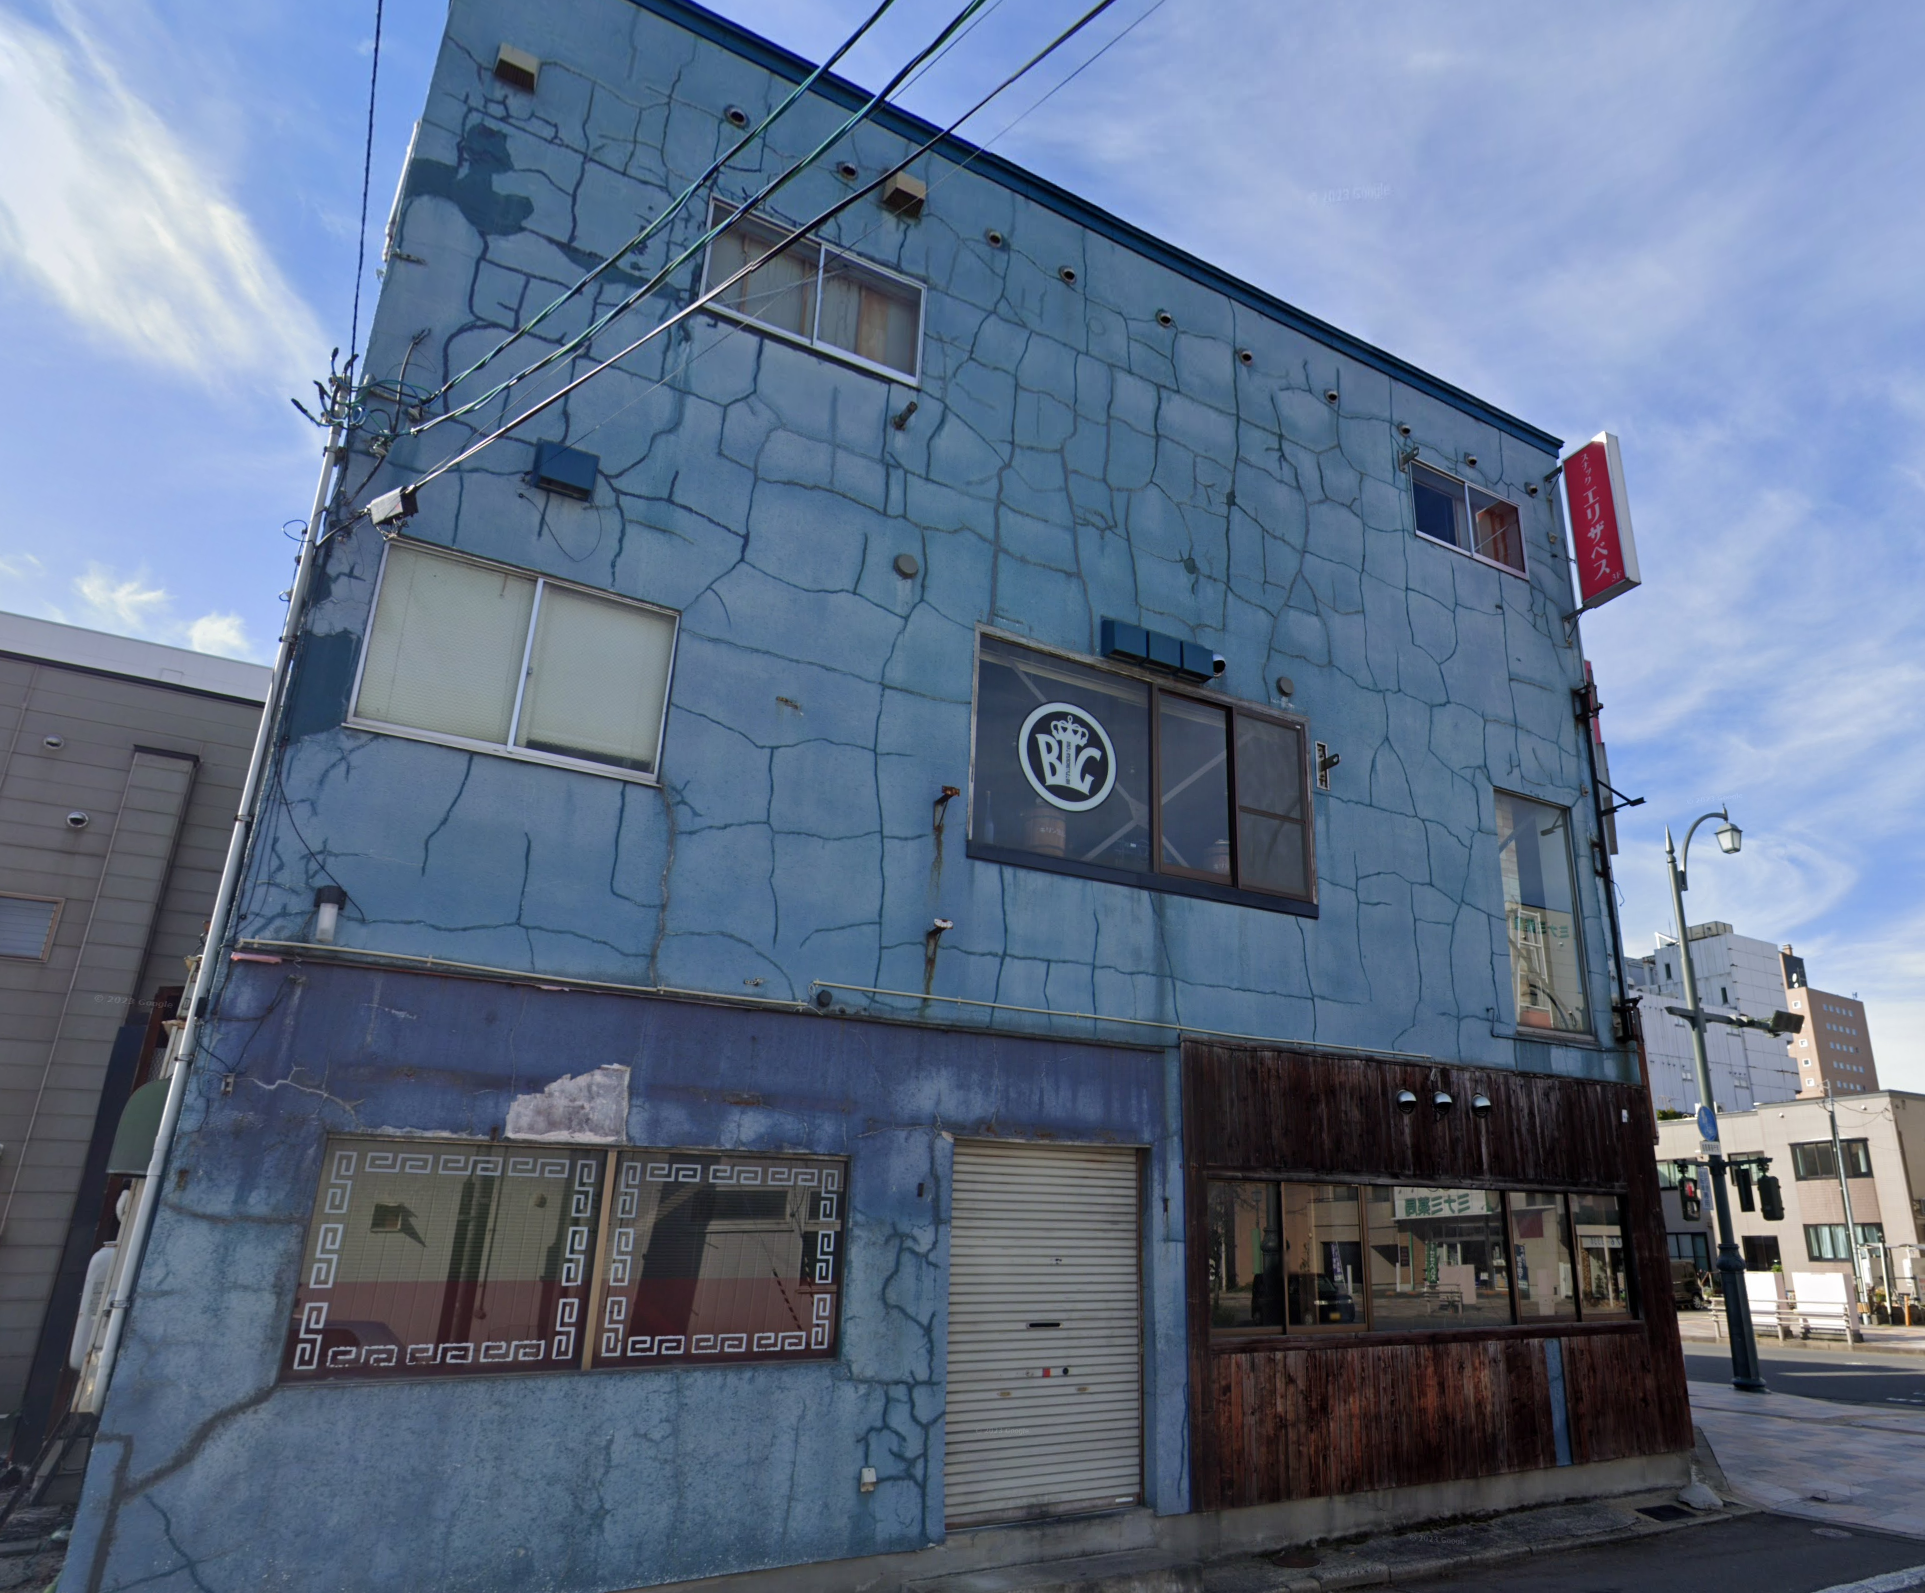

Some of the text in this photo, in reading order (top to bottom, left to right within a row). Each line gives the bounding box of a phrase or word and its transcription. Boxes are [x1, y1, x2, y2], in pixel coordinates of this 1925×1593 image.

[1581, 452, 1592, 486] スナック
[1583, 486, 1610, 581] エリザベス
[1611, 570, 1622, 582] 3F
